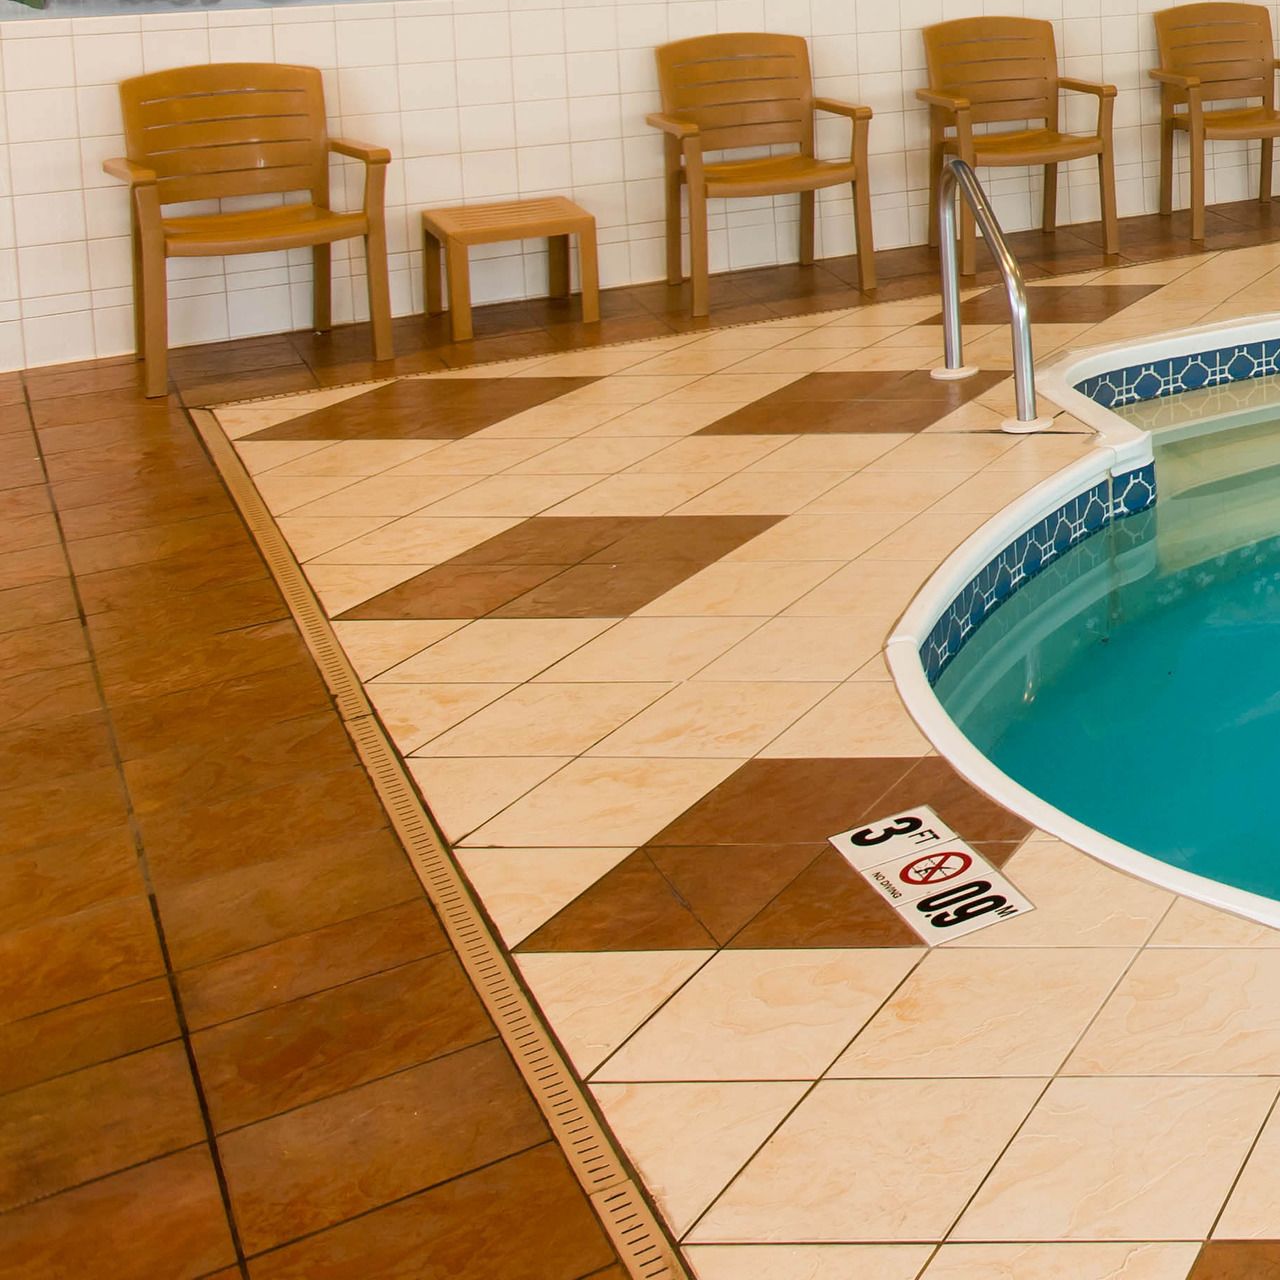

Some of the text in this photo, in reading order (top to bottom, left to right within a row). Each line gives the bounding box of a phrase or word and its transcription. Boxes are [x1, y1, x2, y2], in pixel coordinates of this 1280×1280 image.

[850, 816, 940, 847] 3 FT
[872, 871, 902, 899] NO DIVING
[995, 905, 1019, 918] M
